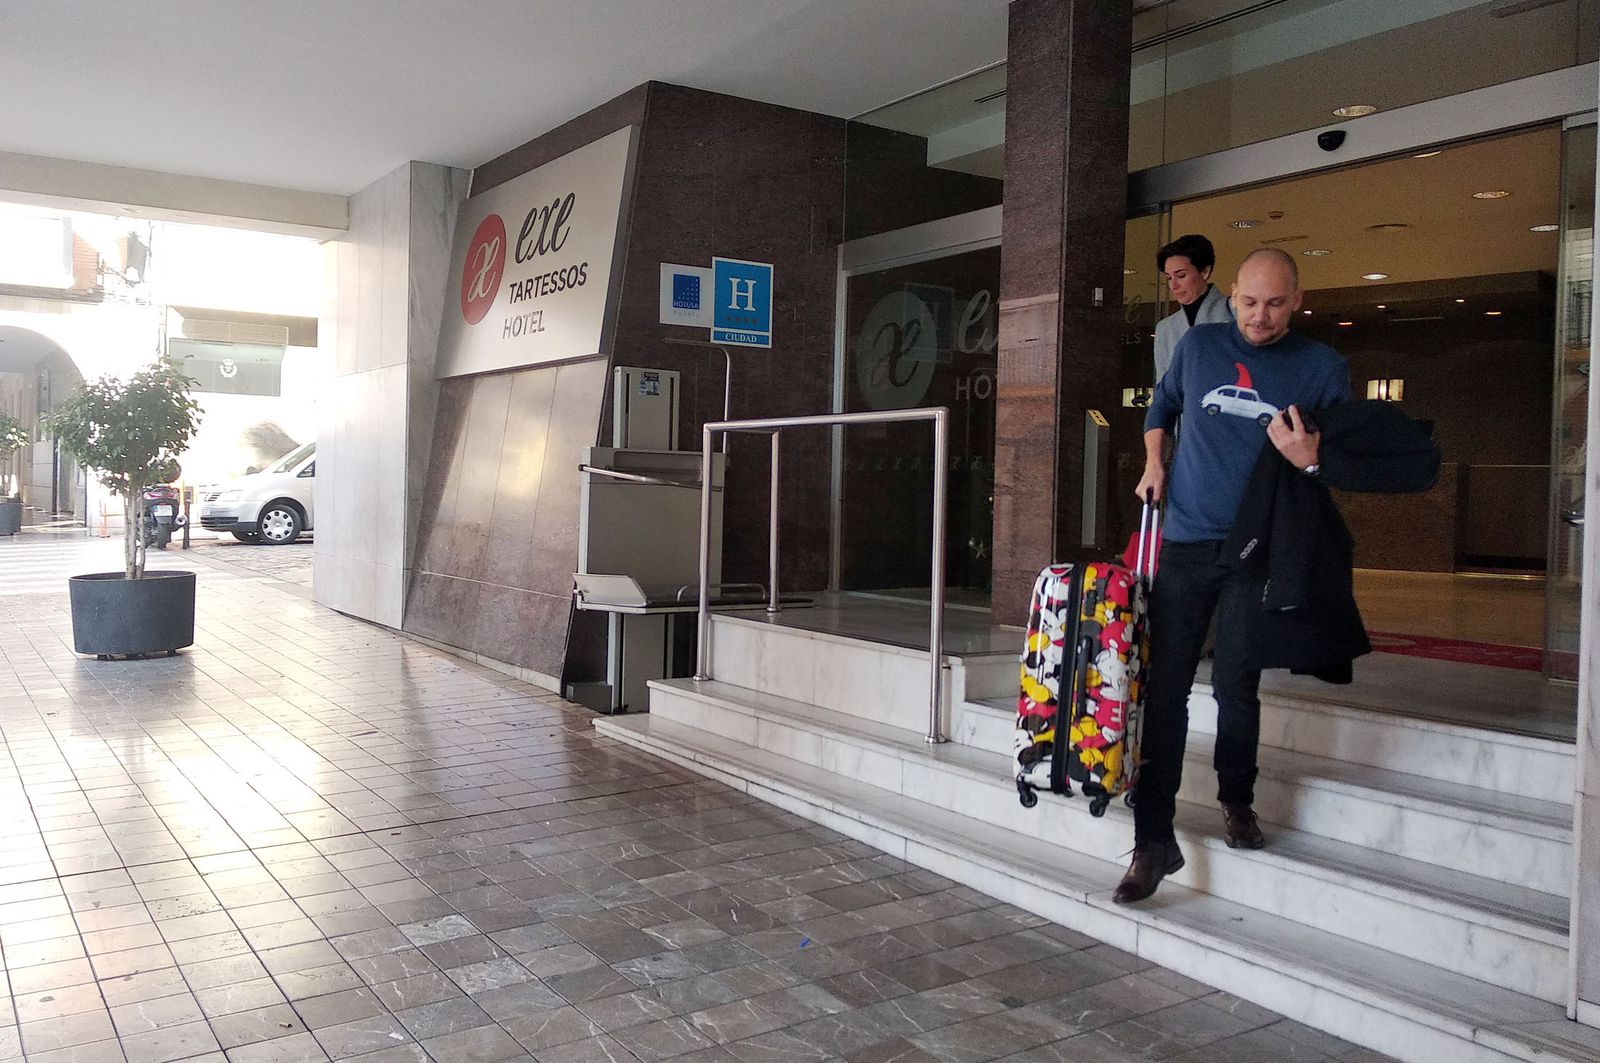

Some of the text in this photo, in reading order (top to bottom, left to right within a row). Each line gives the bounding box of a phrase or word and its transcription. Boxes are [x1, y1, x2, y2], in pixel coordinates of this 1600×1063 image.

[515, 191, 576, 265] exe
[509, 261, 589, 305] TARTESSOS
[728, 277, 757, 312] H
[673, 301, 699, 309] HOTUSA
[502, 309, 546, 340] HOTEL
[725, 332, 758, 343] CIUDAD
[1120, 332, 1142, 345] LS
[955, 374, 998, 401] HO
